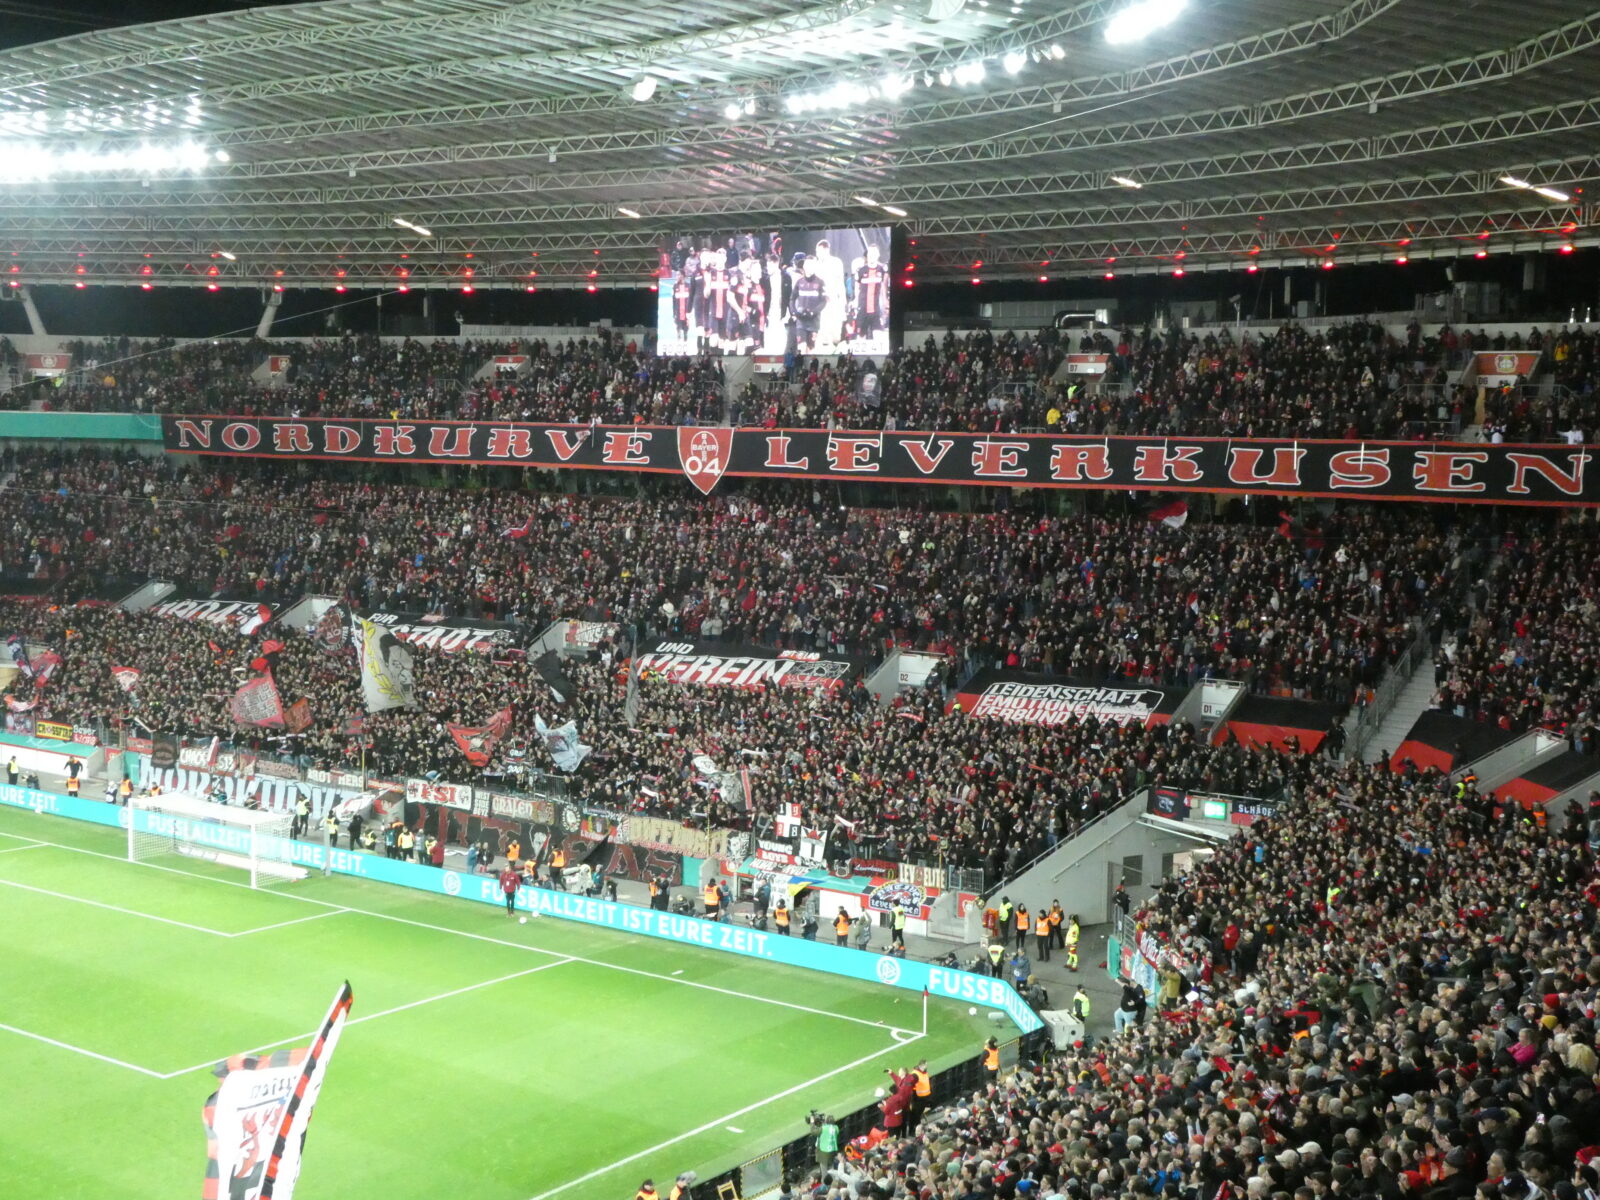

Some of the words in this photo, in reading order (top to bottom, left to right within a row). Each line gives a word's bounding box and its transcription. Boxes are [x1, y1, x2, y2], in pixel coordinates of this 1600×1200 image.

[175, 419, 653, 465] NORDKURVE
[685, 456, 721, 476] 04
[764, 436, 1593, 496] LEVERKUSEN
[390, 624, 495, 654] STADT
[655, 641, 695, 655] UND
[637, 653, 797, 687] VEREIN
[900, 673, 909, 682] D2
[980, 694, 1108, 713] EMOTIONEN
[988, 683, 1148, 704] LEIDENSCHAFT
[1203, 704, 1213, 714] D1
[0, 785, 26, 805] URE
[28, 791, 60, 812] ZEIT.
[329, 849, 367, 874] ZEIT.
[899, 863, 915, 883] LEV
[923, 867, 946, 888] ELITE
[481, 880, 617, 925] FUSBALLZEIT
[623, 908, 654, 932] IST
[657, 913, 713, 945] EURE
[719, 926, 773, 957] ZEIT.
